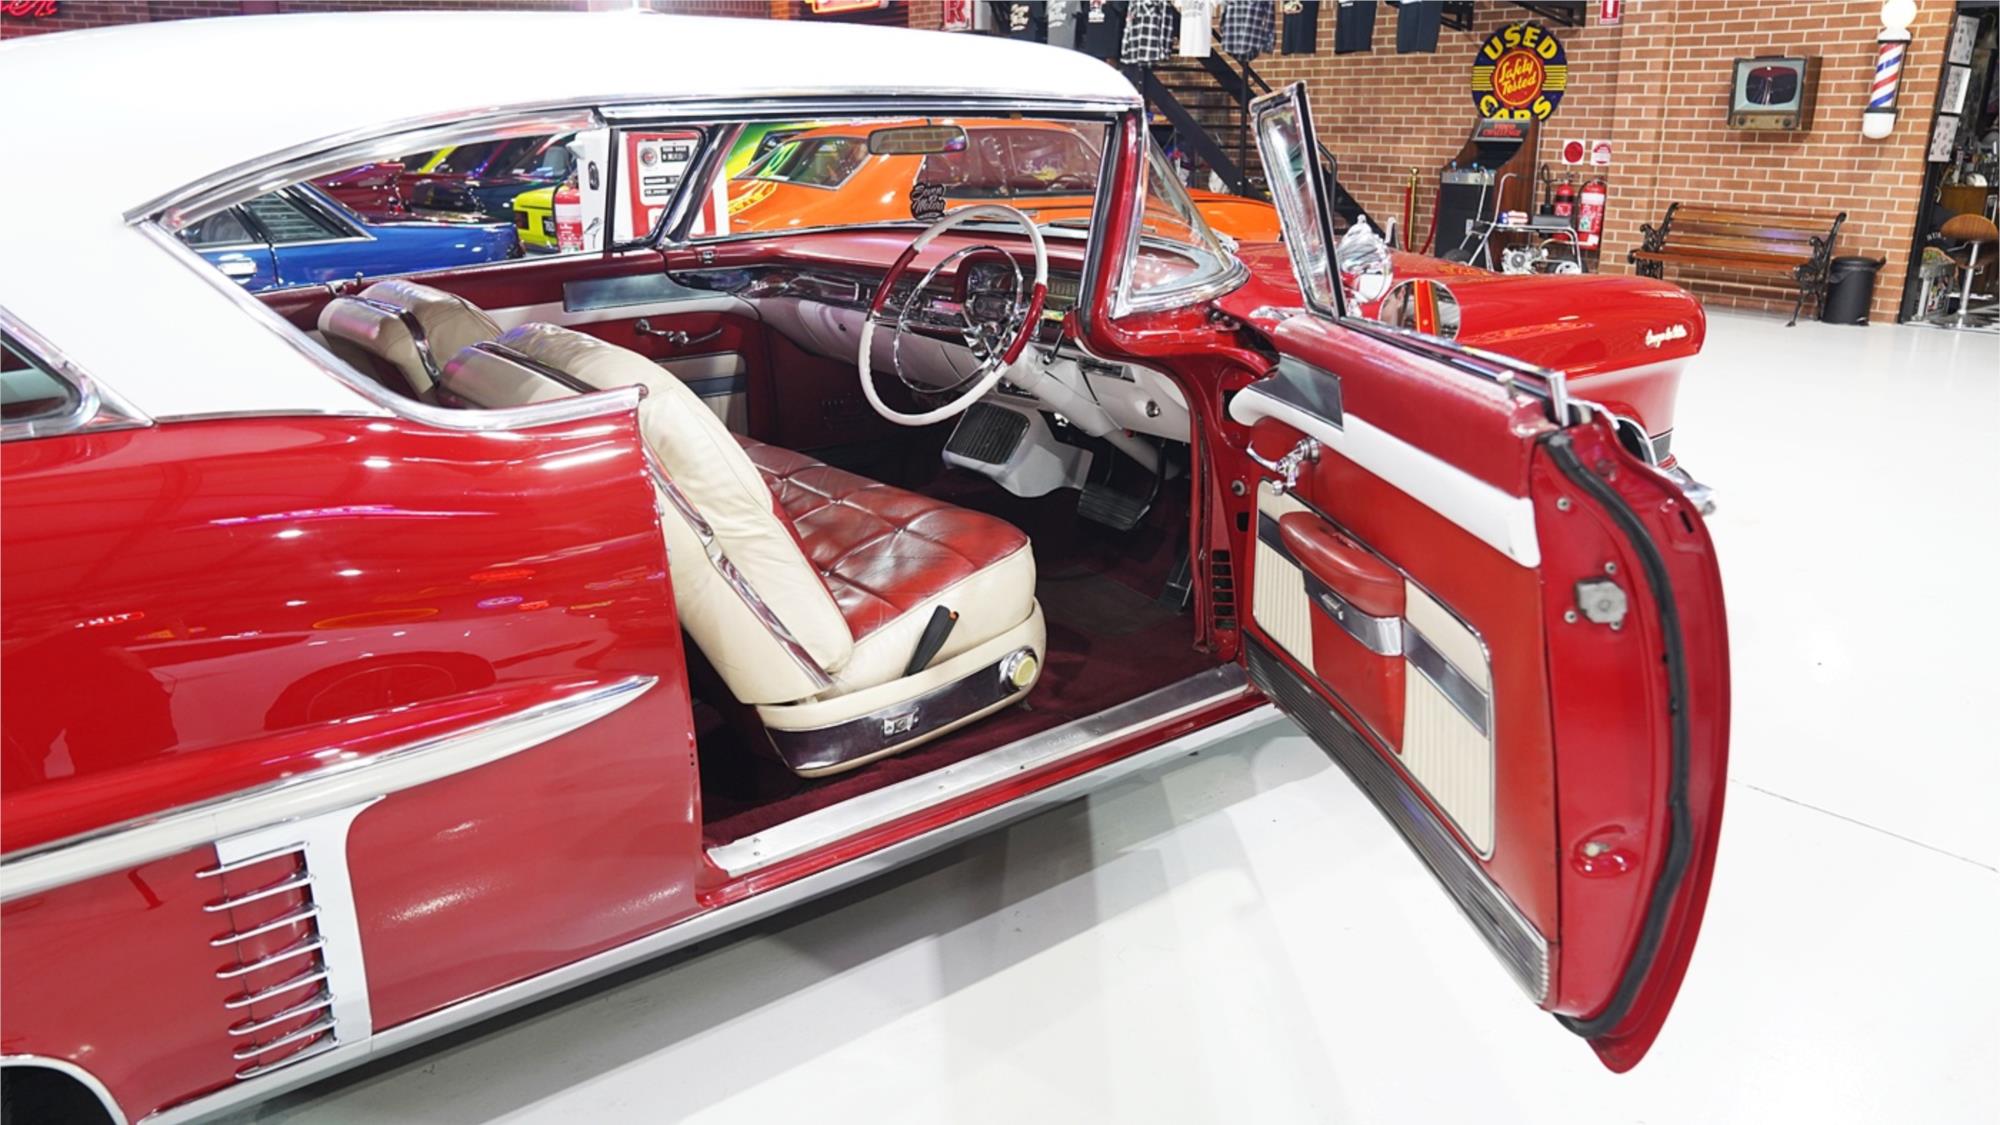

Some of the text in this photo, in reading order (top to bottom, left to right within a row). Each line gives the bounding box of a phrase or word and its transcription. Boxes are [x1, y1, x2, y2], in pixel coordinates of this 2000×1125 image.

[1483, 25, 1558, 60] USED
[1498, 58, 1534, 84] Safety
[1502, 71, 1538, 96] Tested
